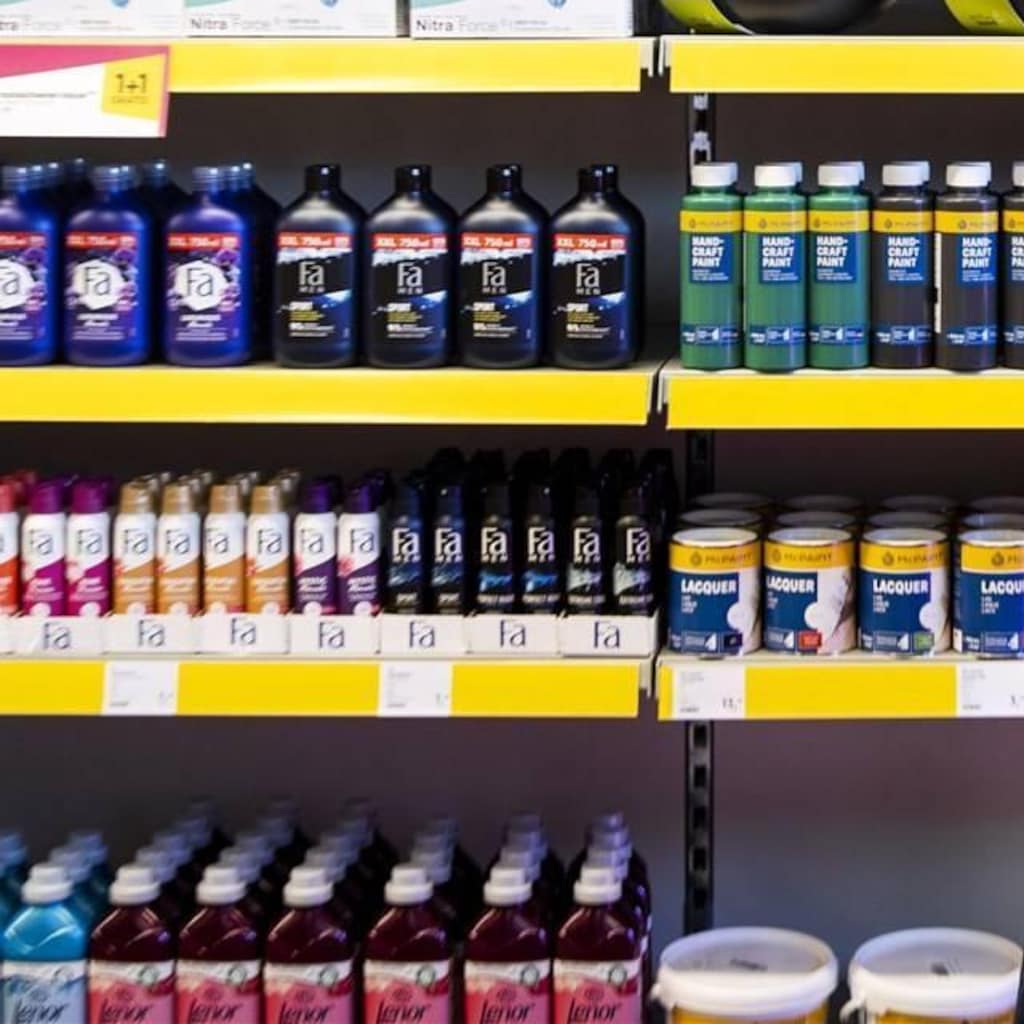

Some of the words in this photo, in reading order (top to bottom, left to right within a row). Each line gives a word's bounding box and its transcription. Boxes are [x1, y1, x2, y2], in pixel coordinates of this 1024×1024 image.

[191, 17, 228, 31] Nitra
[415, 18, 454, 32] Nitra
[692, 247, 723, 257] CRAFT
[692, 258, 721, 267] PAINT
[762, 247, 794, 257] CRAFT
[762, 258, 791, 267] PAINT
[816, 247, 848, 257] CRAFT
[816, 257, 846, 267] PAINT
[888, 247, 920, 257] CRAFT
[888, 258, 917, 267] PAINT
[962, 247, 992, 257] CRAFT
[962, 258, 990, 267] PAINT
[82, 267, 112, 296] Fa
[185, 267, 214, 296] Fa
[298, 261, 325, 287] Fa
[397, 261, 423, 287] Fa
[481, 261, 507, 287] Fa
[575, 262, 601, 288] Fa
[124, 529, 149, 554] Fa
[166, 529, 191, 554] Fa
[207, 529, 230, 554] Fa
[257, 529, 283, 554] Fa
[301, 528, 324, 554] Fa
[350, 528, 375, 553] Fa
[392, 528, 420, 555] Fa
[435, 528, 462, 554] Fa
[481, 527, 508, 554] Fa
[528, 527, 555, 554] Fa
[573, 528, 601, 554] Fa
[626, 527, 651, 554] Fa
[681, 579, 737, 594] LACQUER
[766, 576, 815, 592] LACQUER
[873, 579, 929, 594] LACQUER
[44, 622, 71, 650] Fa
[138, 619, 165, 647] Fa
[231, 617, 257, 645] Fa
[319, 621, 345, 649] Fa
[409, 620, 436, 649] Fa
[500, 619, 526, 647] Fa
[594, 621, 620, 649] Fa
[376, 1001, 431, 1024] Lenor
[480, 1001, 536, 1024] Lenor
[568, 1001, 622, 1024] Lenor
